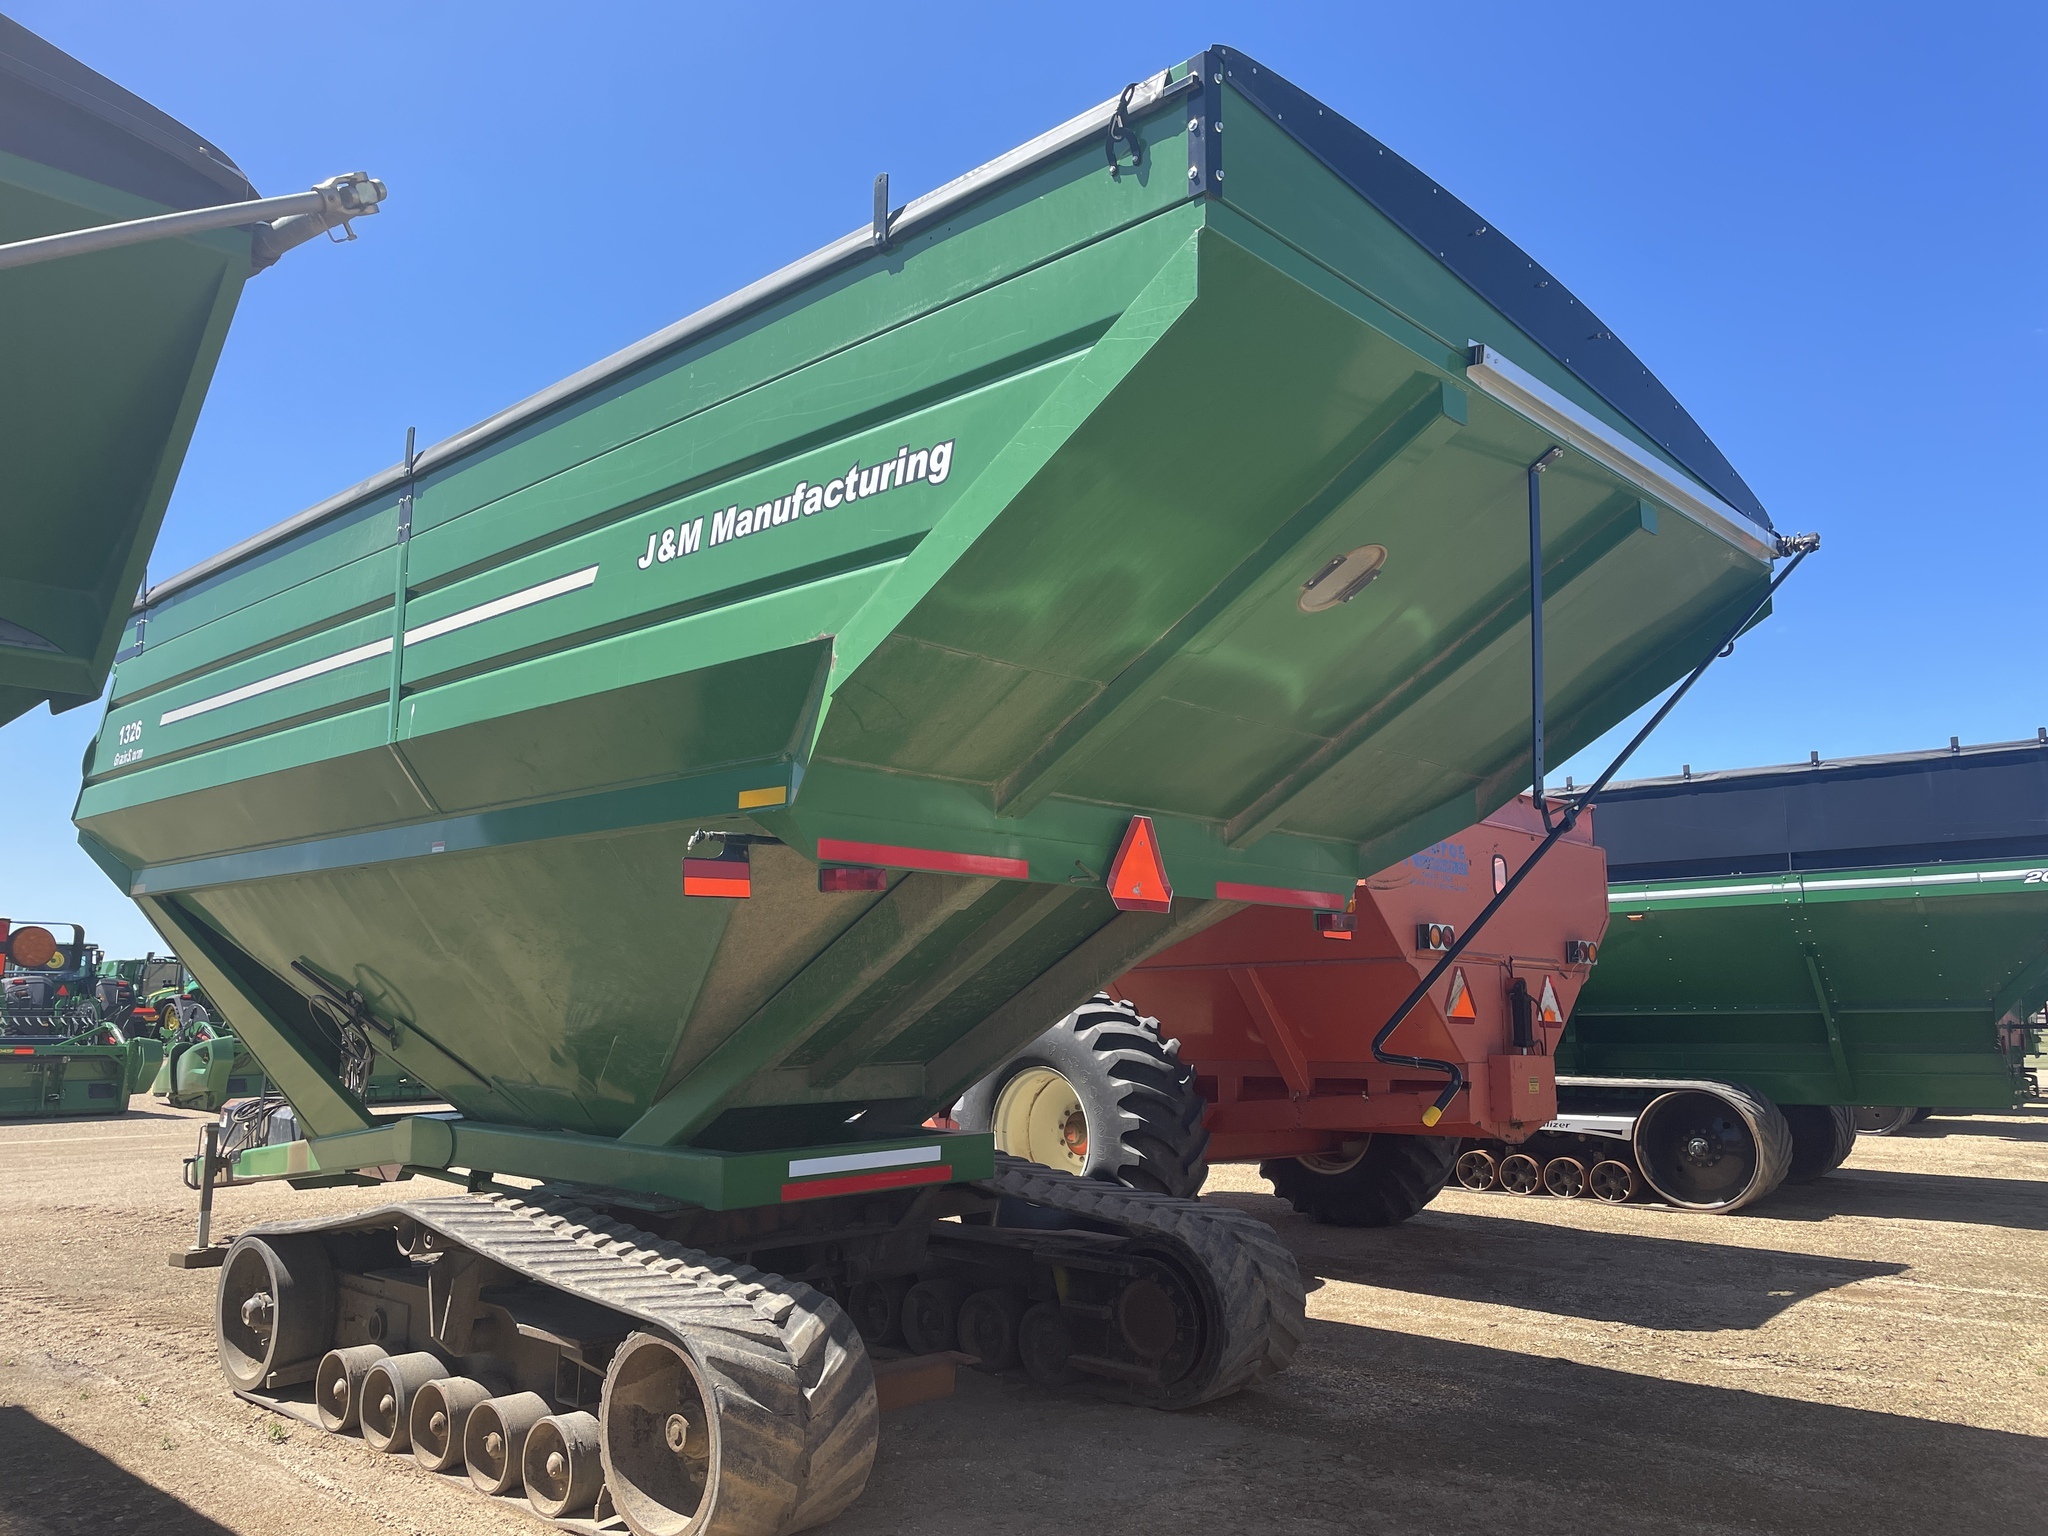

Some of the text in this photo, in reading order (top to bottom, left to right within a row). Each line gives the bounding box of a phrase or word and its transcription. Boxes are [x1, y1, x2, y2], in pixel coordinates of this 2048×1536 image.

[637, 438, 955, 570] J&M Manufacturing
[119, 719, 143, 746] 1326
